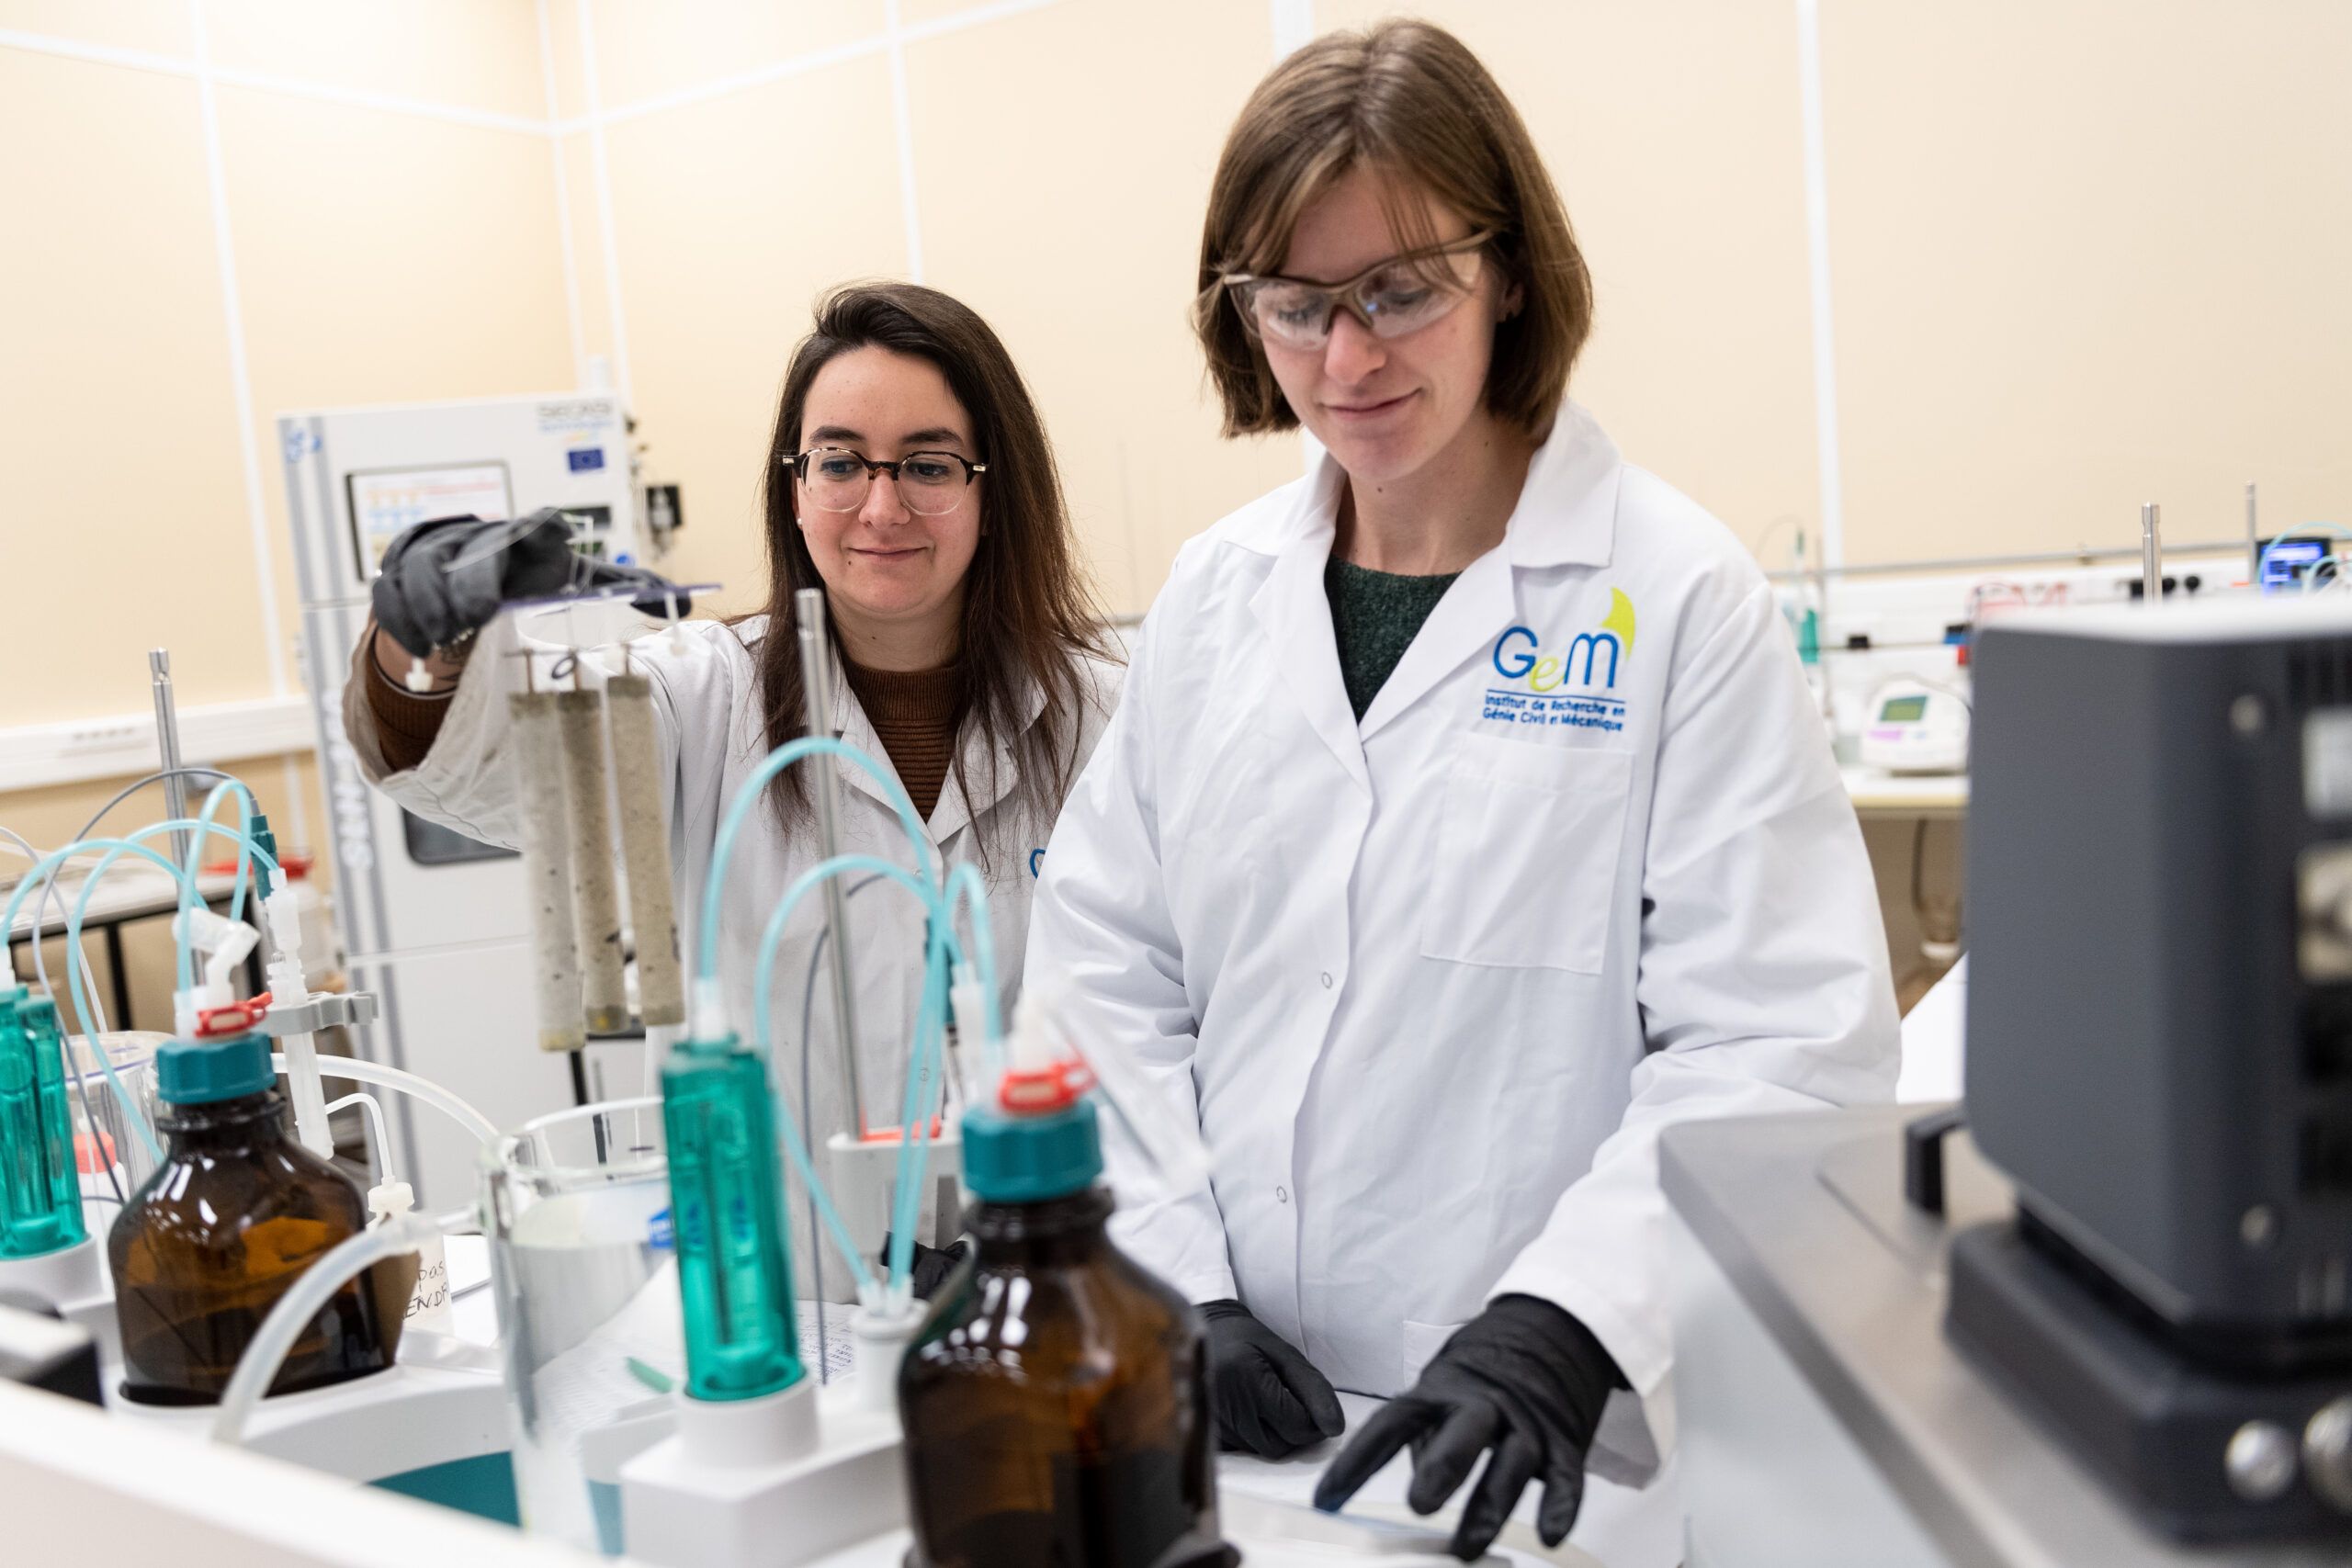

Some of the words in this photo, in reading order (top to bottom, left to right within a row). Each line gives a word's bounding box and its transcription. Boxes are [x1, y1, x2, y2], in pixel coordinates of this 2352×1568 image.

[1485, 695, 1527, 709] Institut
[1532, 699, 1545, 711] de
[1551, 700, 1607, 716] Recherche
[1612, 706, 1625, 716] en
[1483, 706, 1515, 722] Génie
[1520, 711, 1546, 725] Civil
[1561, 714, 1623, 732] Mécanique
